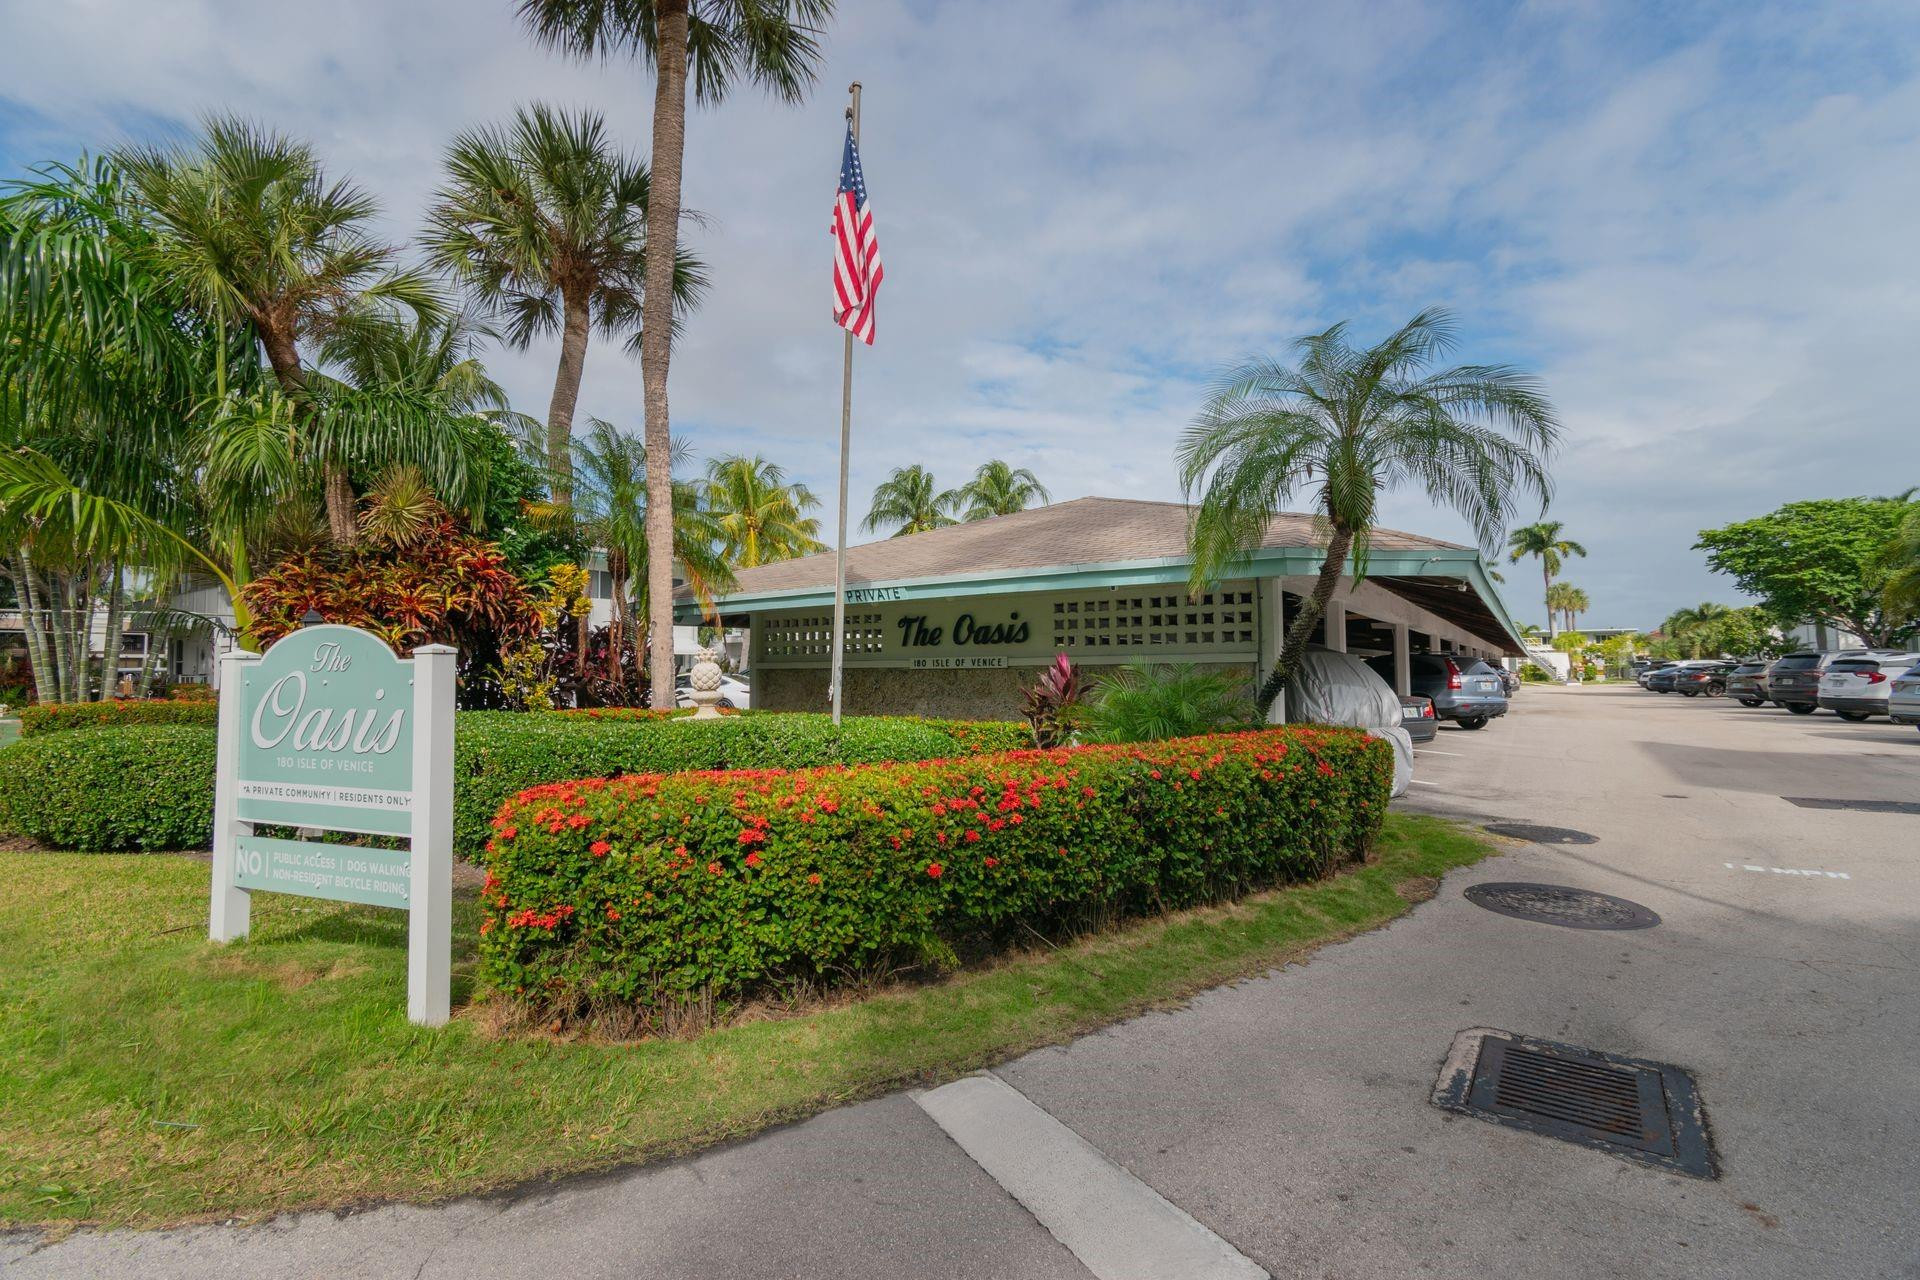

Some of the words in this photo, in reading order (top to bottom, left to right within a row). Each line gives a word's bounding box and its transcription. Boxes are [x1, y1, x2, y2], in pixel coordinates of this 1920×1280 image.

[846, 588, 901, 602] PRIVATE
[897, 615, 944, 647] The
[953, 612, 1030, 646] Oasis
[310, 642, 352, 672] The
[914, 659, 927, 667] 180
[932, 658, 950, 667] ISLE
[955, 658, 966, 667] OF
[971, 657, 1002, 667] VENICE
[251, 671, 405, 754] Oasis
[276, 757, 293, 768] 180
[297, 758, 317, 770] ISLE
[320, 759, 334, 771] OF
[336, 760, 374, 773] VENICE
[252, 786, 283, 796] PRIVATE
[285, 788, 331, 801] COMMUNITY
[339, 793, 383, 804] RESIDENTS
[237, 851, 262, 875] NO
[273, 853, 301, 865] PUBLIC
[303, 856, 336, 869] ACCESS
[347, 859, 367, 873] DOG
[272, 868, 333, 883] NON-RESIDENT
[335, 875, 372, 891] BICYCLE
[373, 880, 406, 895] RIDING
